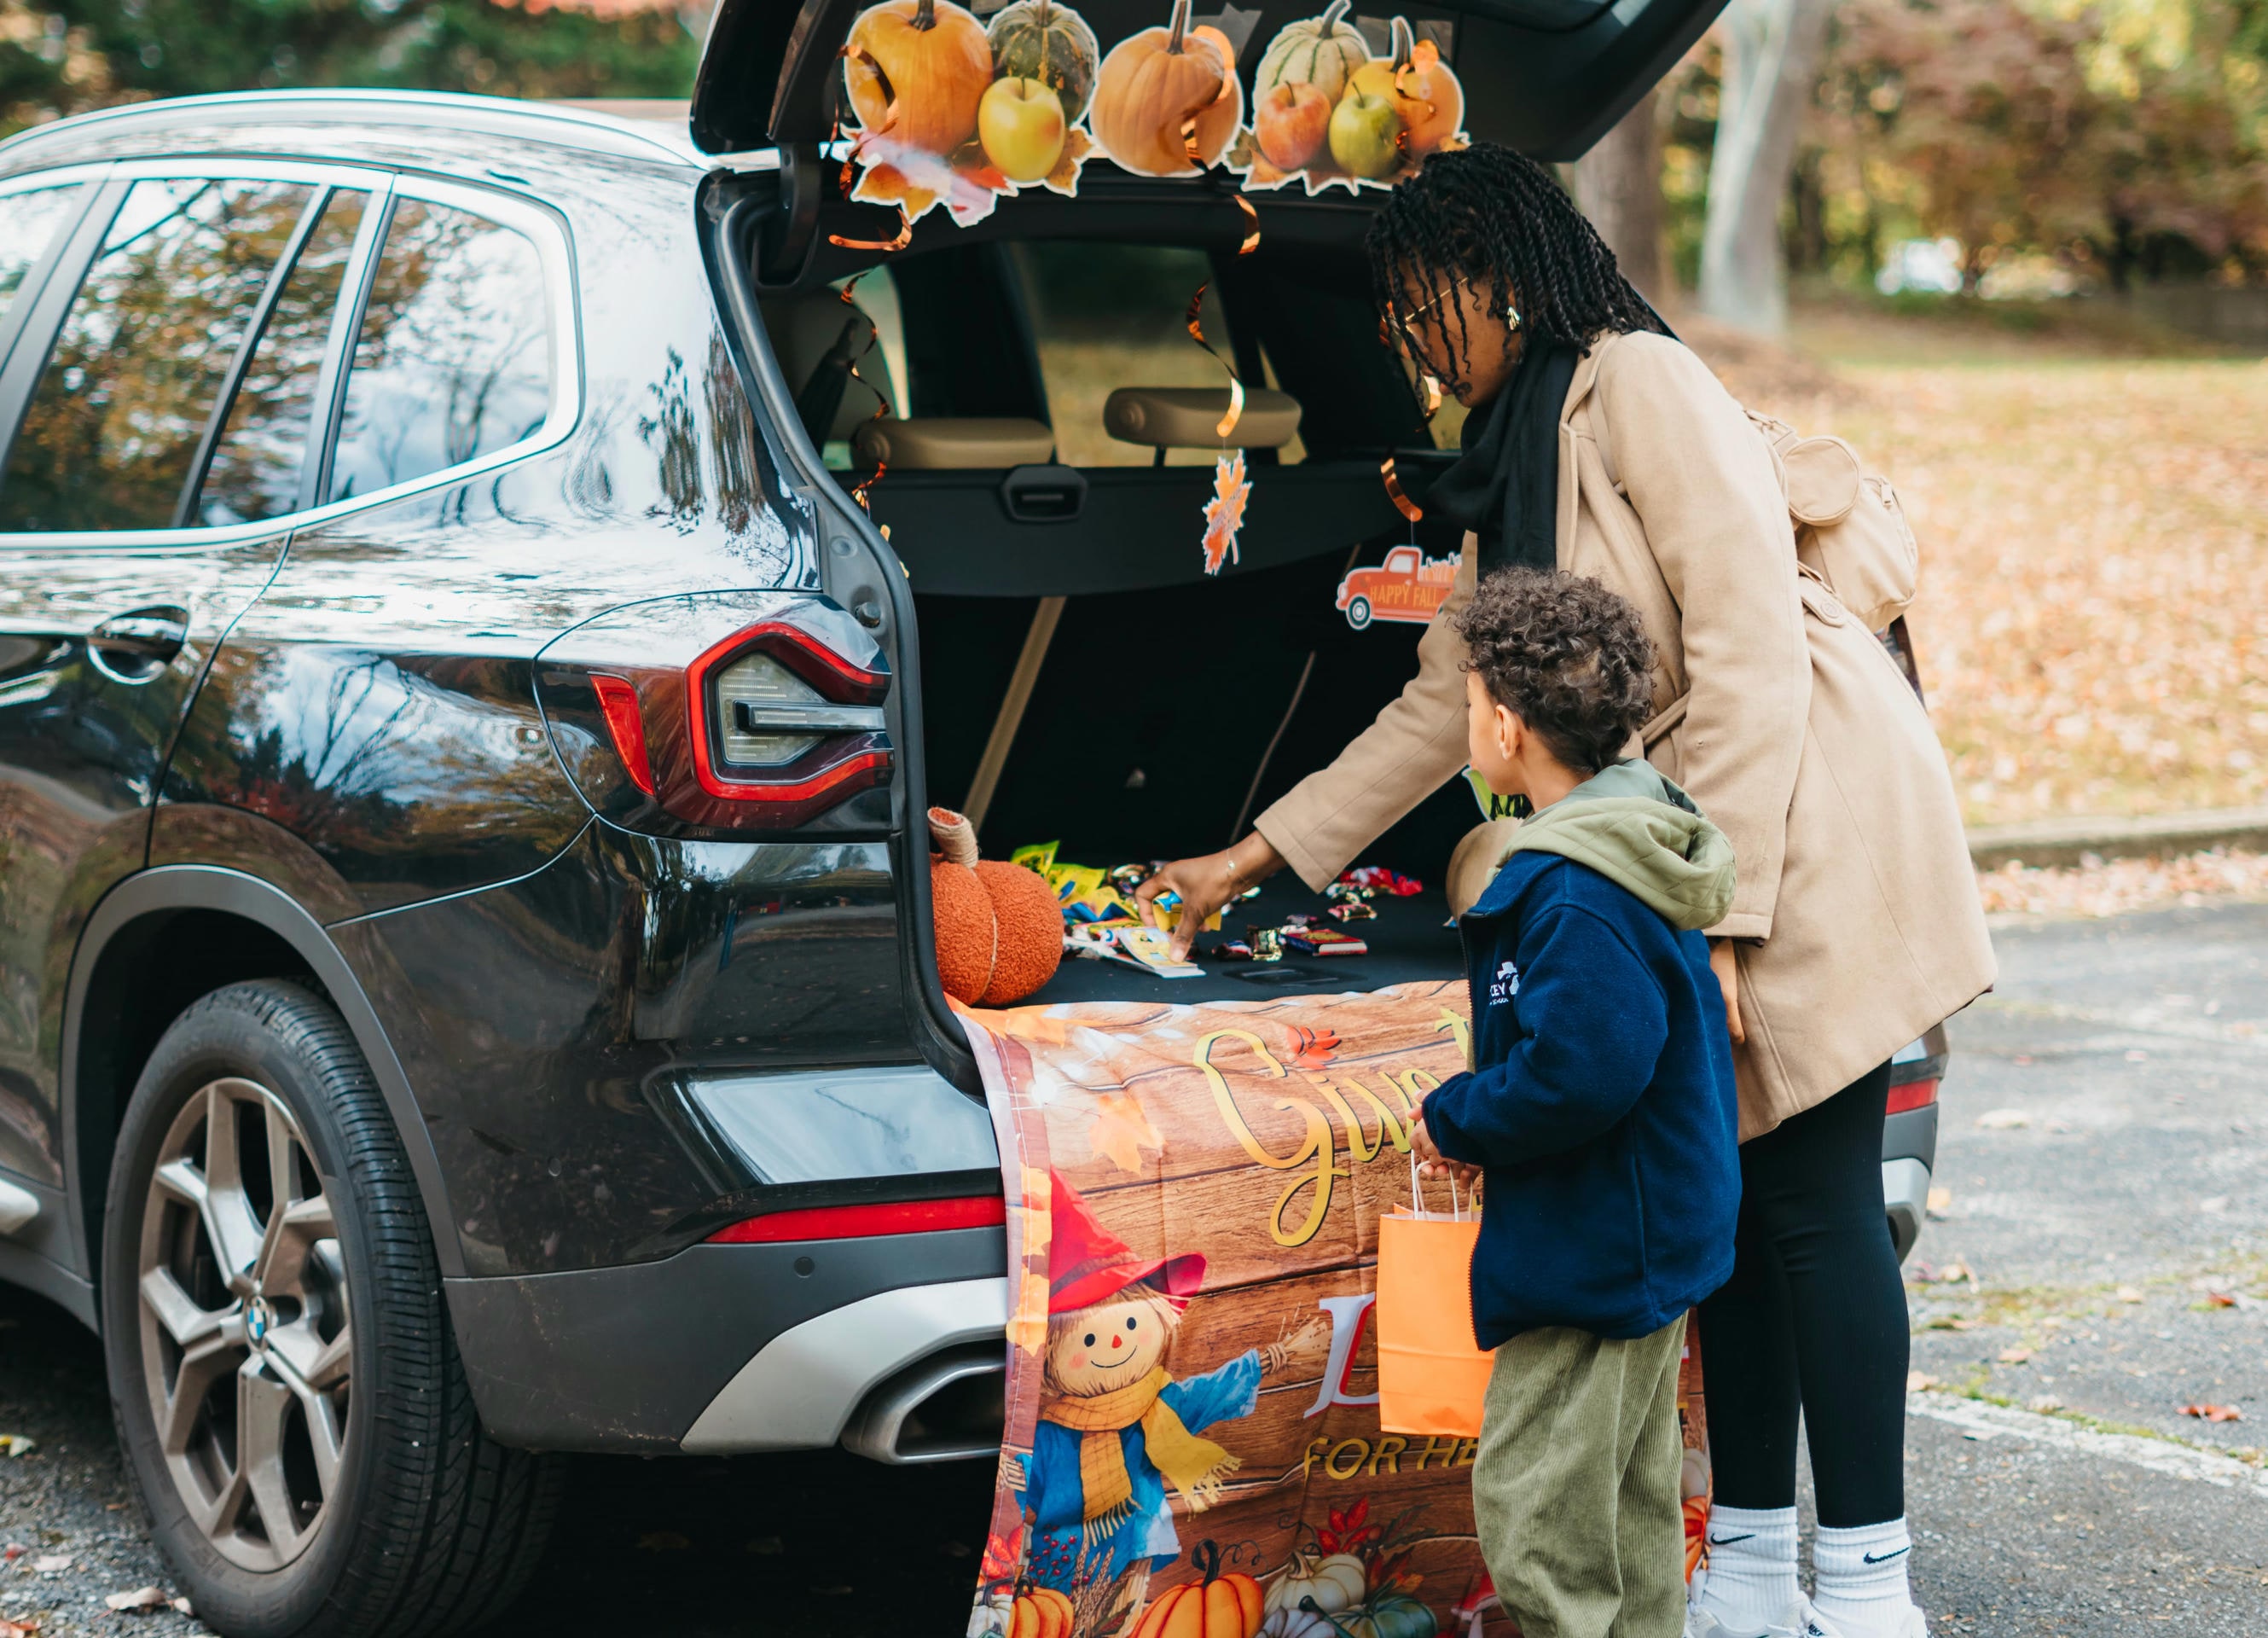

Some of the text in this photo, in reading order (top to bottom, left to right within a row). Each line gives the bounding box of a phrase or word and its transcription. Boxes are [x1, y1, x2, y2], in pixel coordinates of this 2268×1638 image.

[1370, 584, 1438, 607] HAPPY FALL
[1304, 1436, 1407, 1483] FOR
